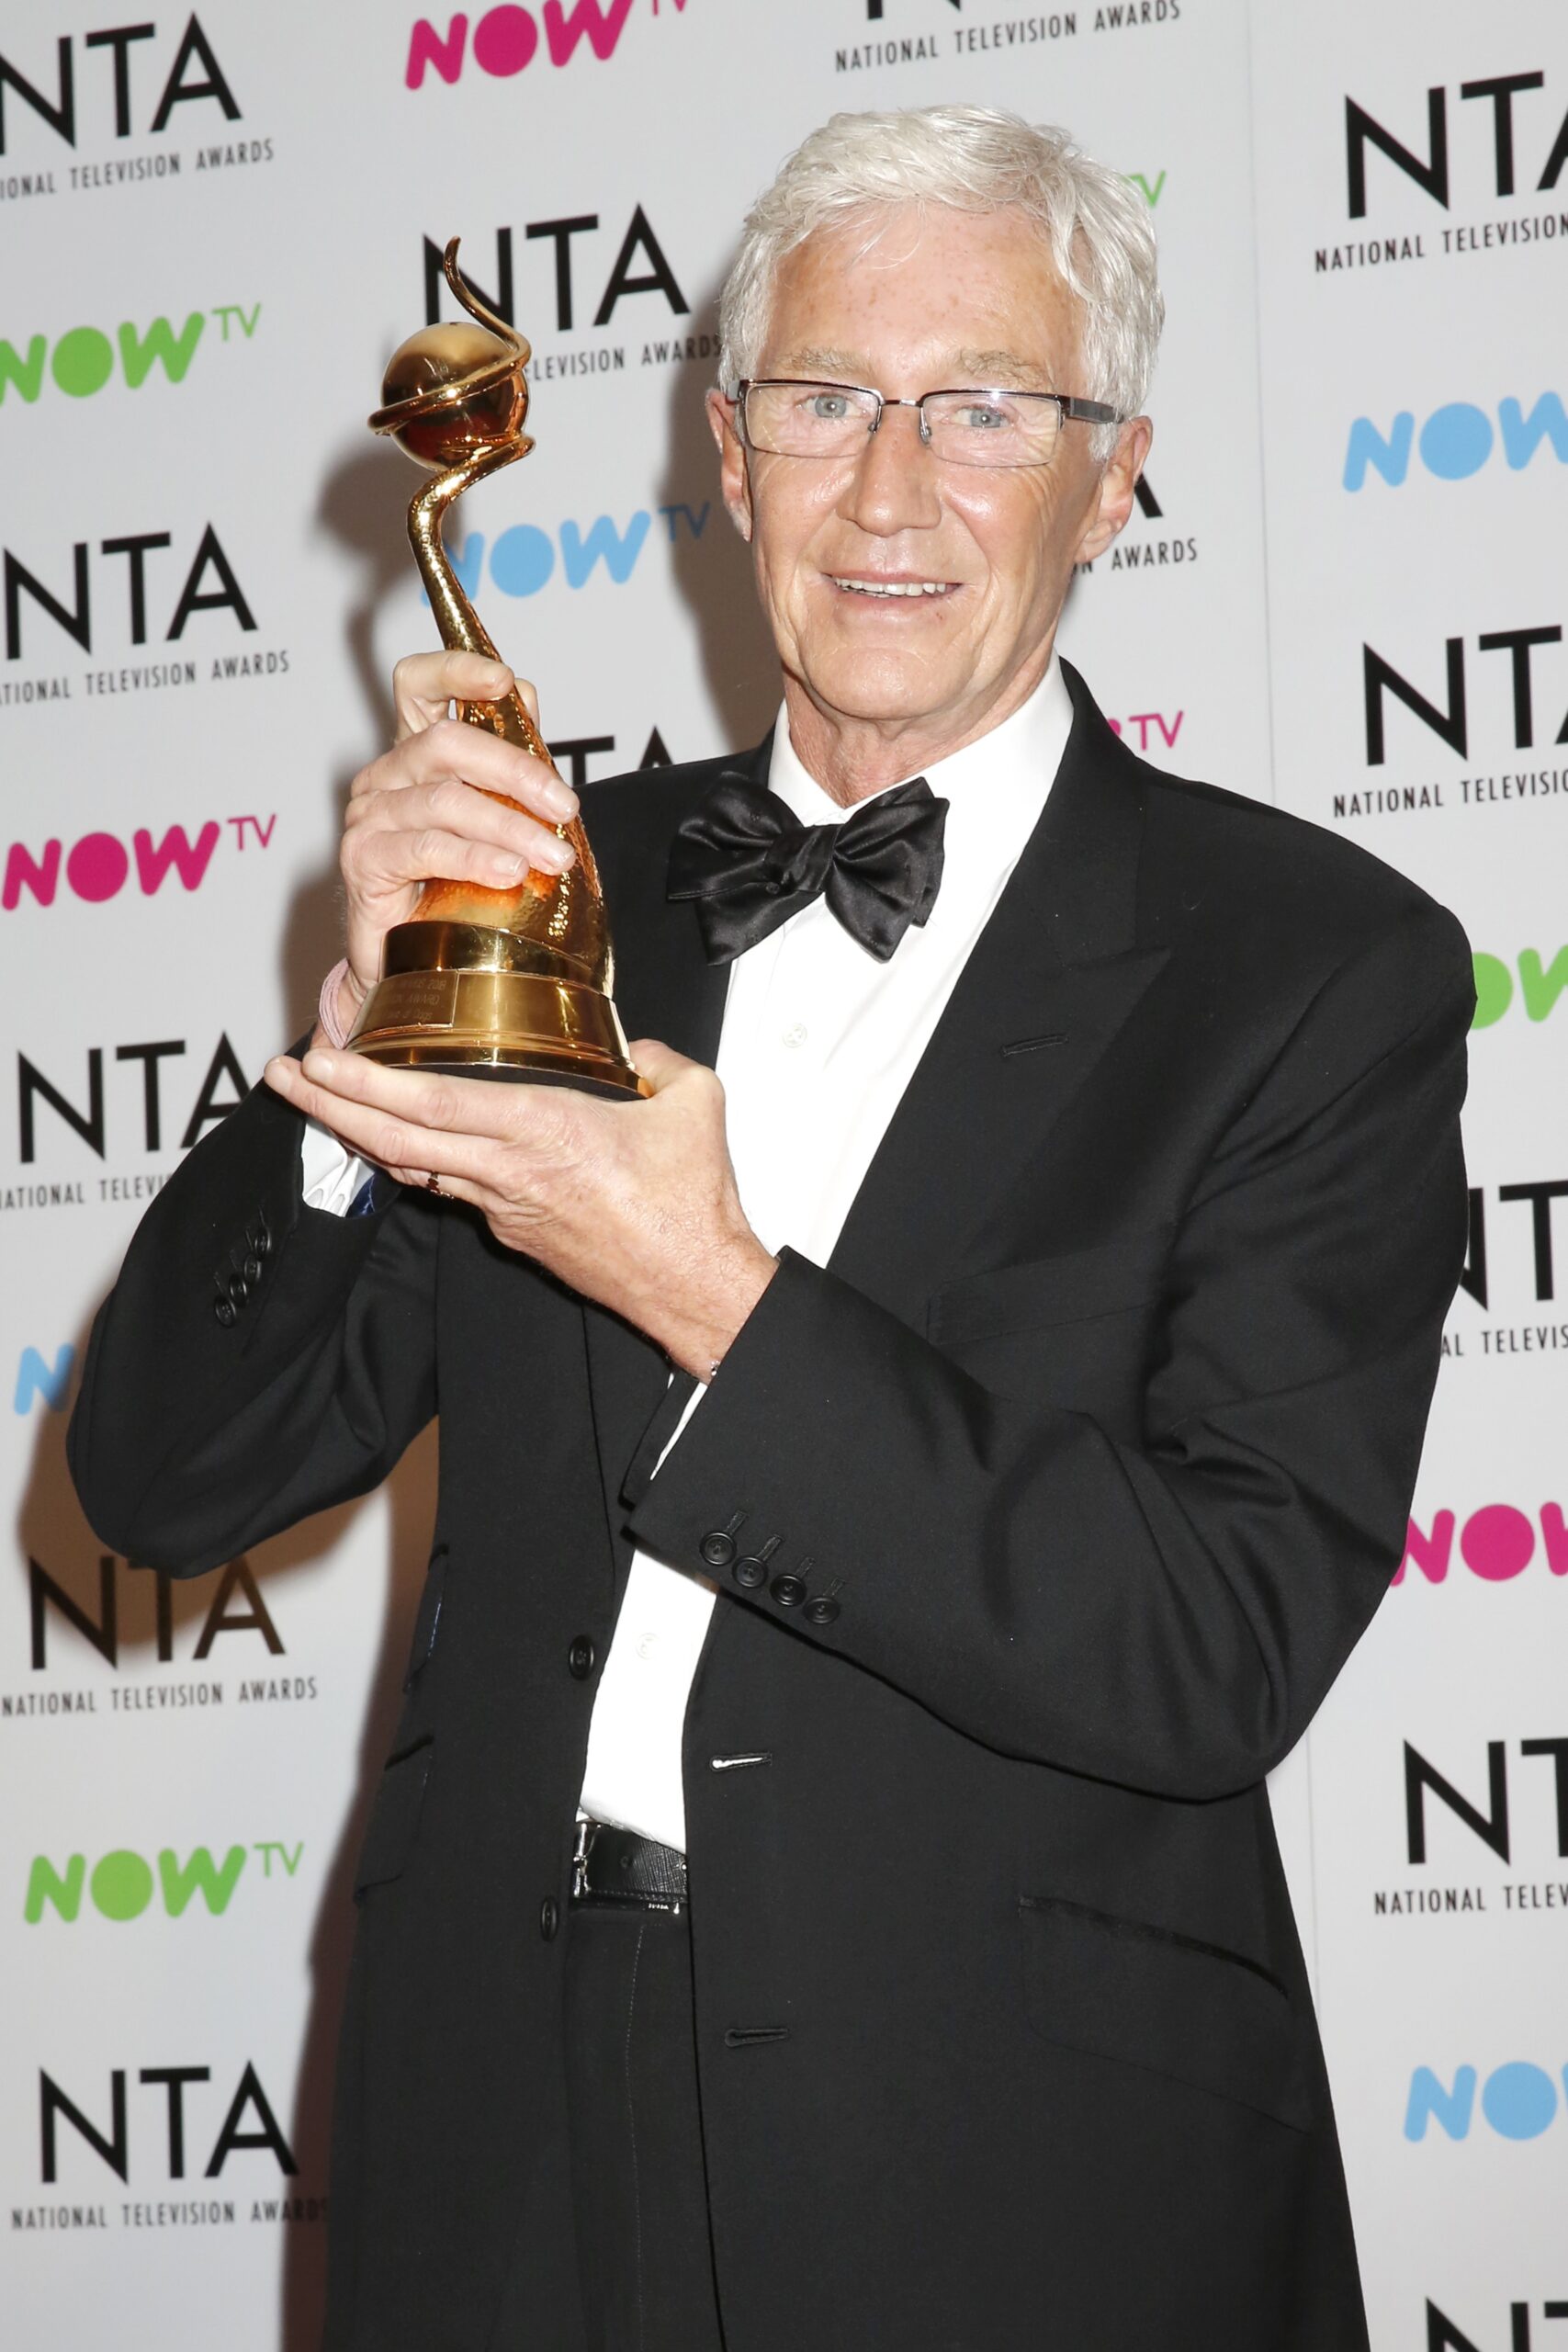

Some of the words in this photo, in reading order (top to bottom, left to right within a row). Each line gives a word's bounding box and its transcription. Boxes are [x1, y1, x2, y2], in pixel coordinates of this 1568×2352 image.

[405, 0, 633, 89] NOW
[836, 36, 938, 73] NATIONAL
[954, 13, 1077, 54] TELEVISION
[1094, 0, 1180, 31] AWARDS
[0, 11, 243, 155] NTA
[70, 153, 181, 189] TELEVISION
[196, 138, 274, 171] AWARDS
[423, 202, 691, 331] NTA
[1315, 233, 1425, 273] NATIONAL
[0, 311, 205, 406] NOW
[211, 302, 261, 342] TV
[658, 502, 710, 543] TV
[1111, 537, 1198, 571] AWARDS
[4, 521, 258, 661] NTA
[0, 676, 71, 707] TIONAL
[85, 662, 196, 695] TELEVISION
[211, 650, 290, 680] AWARDS
[1363, 625, 1568, 766] NT
[1129, 709, 1184, 751] TV
[1334, 783, 1444, 819] NATIONAL
[3, 820, 220, 910] NOW
[228, 813, 277, 851] TV
[17, 1030, 251, 1163] NTA
[28, 1555, 287, 1670] NTA
[2, 1690, 96, 1717] NATIONAL
[111, 1682, 222, 1711] TELEVISION
[239, 1676, 318, 1702] AWARDS
[24, 1845, 247, 1924] NOW
[254, 1841, 304, 1878] TV
[1374, 1887, 1486, 1916] NATIONAL
[39, 2059, 300, 2186] NTA
[12, 2205, 107, 2231] NATIONAL
[123, 2200, 235, 2227] TELEVISION
